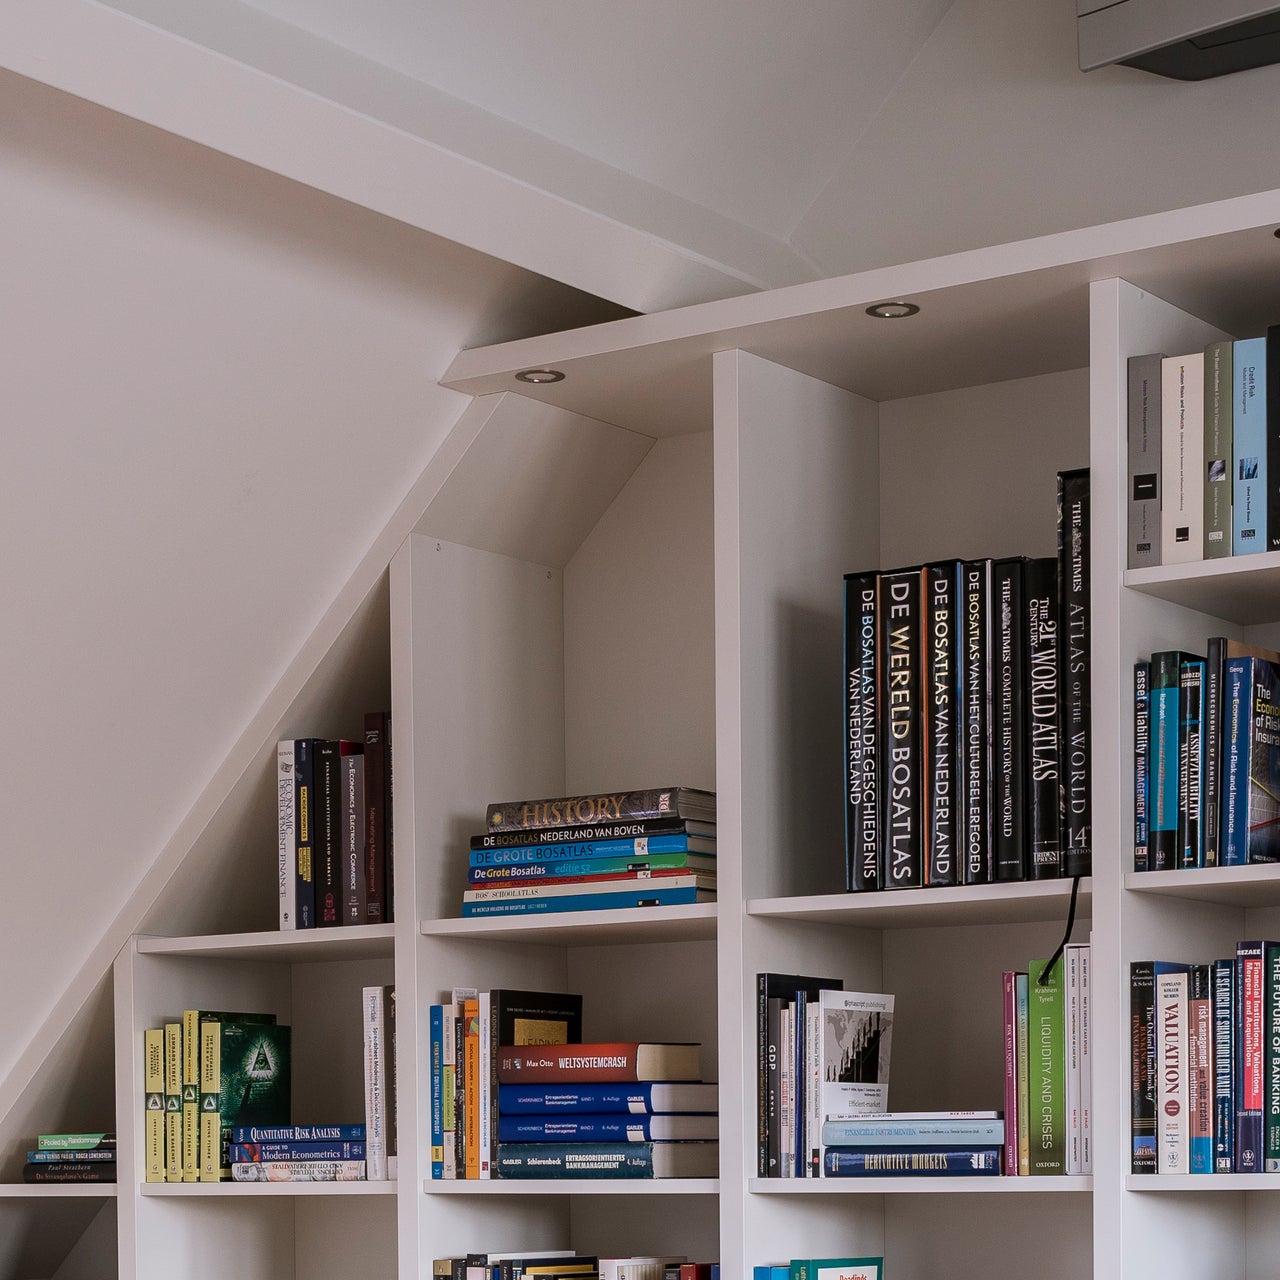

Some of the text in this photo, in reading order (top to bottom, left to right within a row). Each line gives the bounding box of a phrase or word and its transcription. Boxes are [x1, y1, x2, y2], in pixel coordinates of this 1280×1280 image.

[1070, 502, 1085, 814] THE TIMES ATLAS OF THE WORLD
[850, 668, 861, 804] VAN NEDERLAND
[862, 590, 876, 878] DE BOSATLAS VAN DE GESCHIEDENIS
[890, 583, 911, 880] DE WERELD BOSATLAS
[934, 579, 950, 873] DE BOSATLAS VAN NEDERLAND
[969, 572, 980, 872] DE BOSATLAS VAN HET CULTUREEL ERFGOED
[1032, 649, 1057, 781] WORLD ATLAS
[484, 837, 495, 846] DE
[540, 830, 592, 841] NEDERLAND
[596, 828, 612, 837] VAN
[614, 825, 644, 836] BOVEN
[521, 796, 626, 826] HISTORY
[474, 869, 486, 878] De
[487, 868, 510, 878] Grote
[511, 866, 546, 876] Bosatlas
[555, 864, 579, 874] editie
[476, 845, 593, 863] DE GROTE BOSATLAS
[1272, 984, 1280, 1033] FUTURE
[559, 1057, 626, 1069] WELTSYSTEMCRASH
[1165, 1003, 1179, 1094] VALUATION
[1272, 1037, 1280, 1053] OF
[1041, 1017, 1052, 1149] LIQUIDITY AND CRISES
[1271, 1057, 1280, 1114] BANKING
[251, 1127, 340, 1140] QUANTITATIVE RISK ANALYSIS
[263, 1150, 340, 1160] Modern Econometrics
